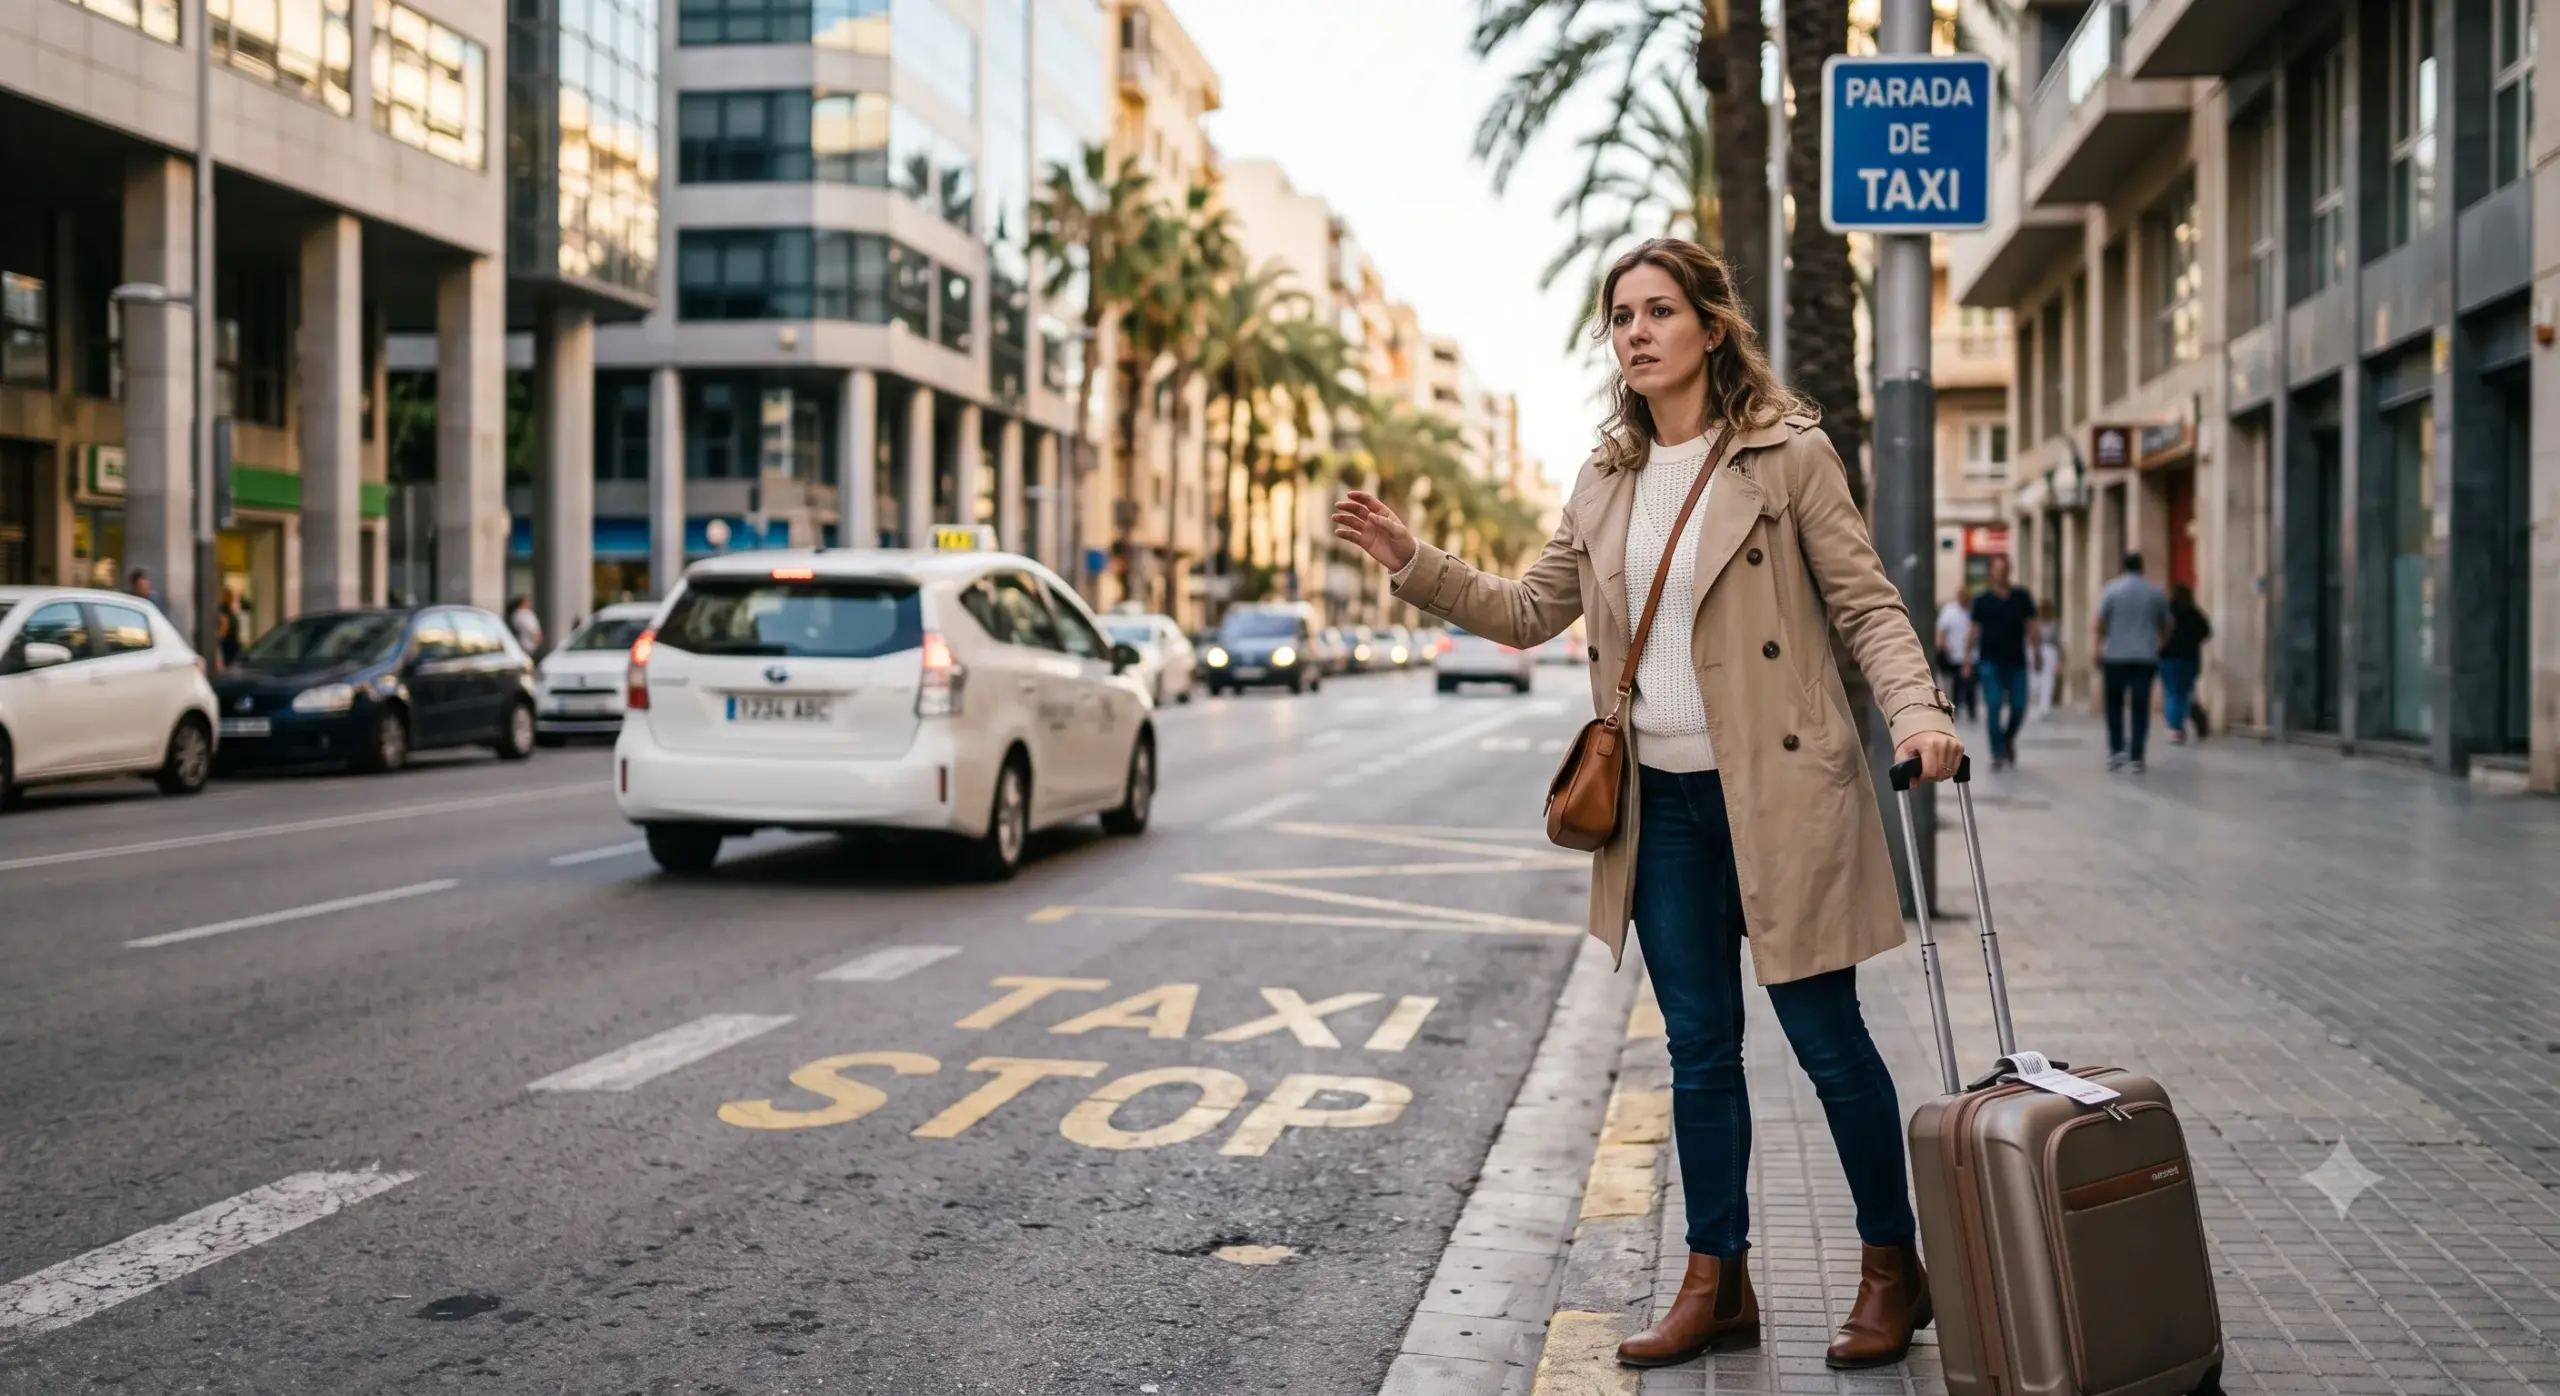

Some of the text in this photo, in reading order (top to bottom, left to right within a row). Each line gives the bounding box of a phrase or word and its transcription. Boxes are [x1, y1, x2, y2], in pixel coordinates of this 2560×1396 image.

[1846, 77, 1973, 108] PARADA
[1889, 122, 1931, 155] DE
[1857, 168, 1960, 212] TAXI
[954, 976, 1439, 1052] TAXI
[717, 1051, 1413, 1157] STOP
